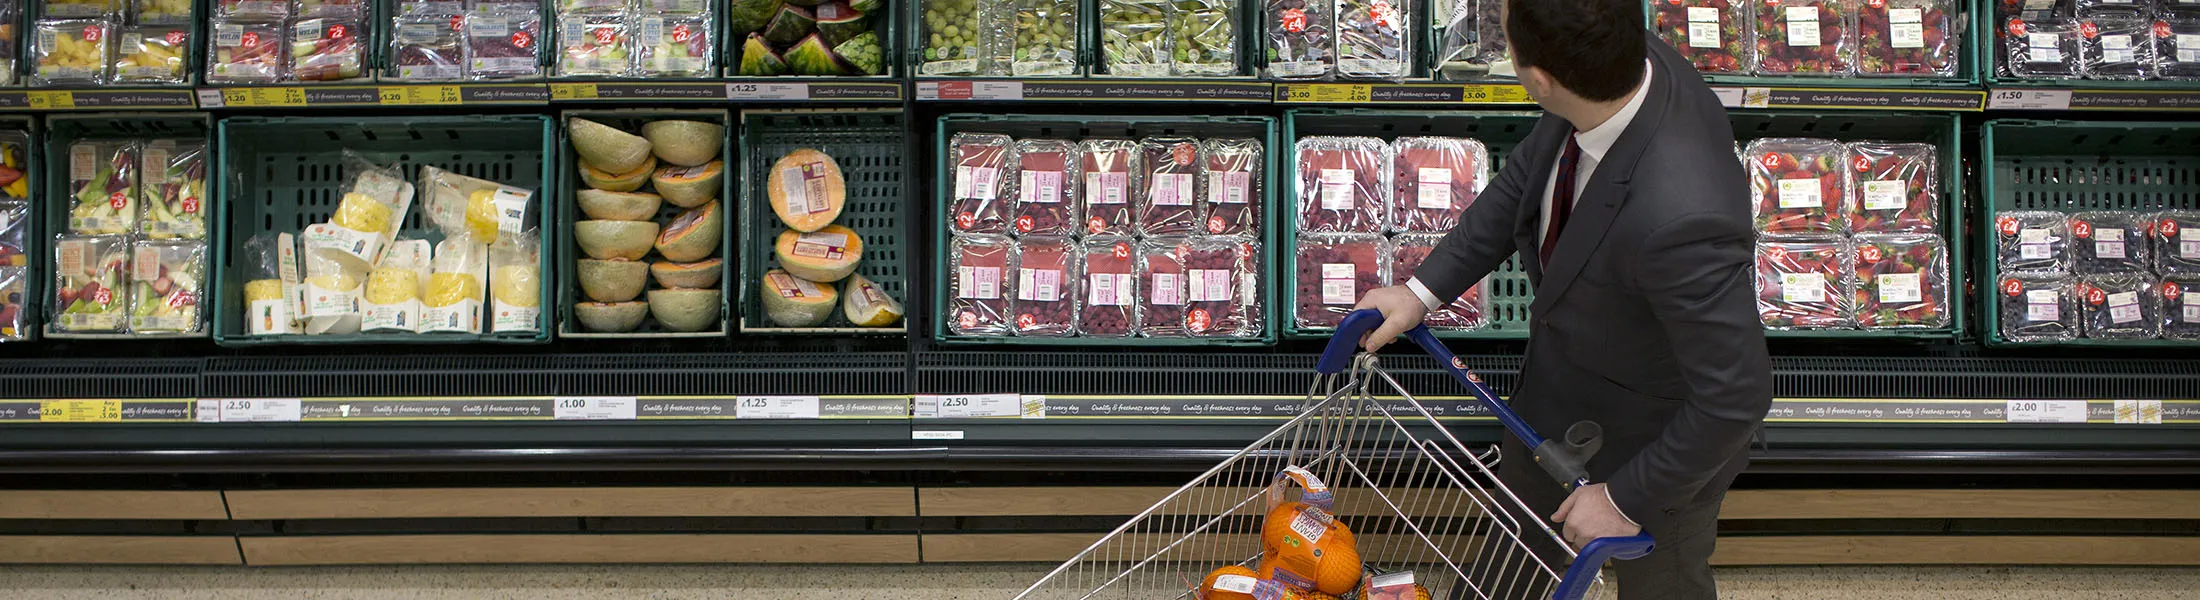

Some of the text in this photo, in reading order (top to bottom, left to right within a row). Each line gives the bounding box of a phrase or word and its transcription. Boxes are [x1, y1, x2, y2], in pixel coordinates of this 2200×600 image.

[1288, 18, 1303, 31] £4
[731, 85, 757, 93] £1.25
[1997, 92, 2022, 100] £1.50
[1766, 154, 1779, 166] £2
[1857, 157, 1868, 169] £2
[961, 214, 973, 227] £2
[1020, 218, 1031, 232] £2
[2003, 221, 2016, 233] £2
[2076, 224, 2088, 235] £2
[2163, 224, 2174, 234] £2
[1116, 246, 1127, 258] £2
[1864, 250, 1876, 261] £2
[2008, 282, 2020, 293] £2
[2165, 286, 2176, 297] £2
[2091, 290, 2102, 301] £2
[226, 401, 251, 410] £2.50
[560, 399, 585, 409] £1.00
[742, 398, 767, 407] £1.25
[943, 397, 968, 407] £2.50
[2012, 402, 2037, 412] £2.00
[373, 405, 393, 415] Quality
[399, 405, 424, 413] freshness
[424, 407, 440, 415] every
[440, 405, 451, 415] day
[462, 404, 482, 415] Quality
[489, 404, 514, 413] freshness
[514, 406, 530, 415] every
[530, 405, 541, 415] day
[643, 403, 663, 414] Quality
[669, 403, 694, 412] freshness
[695, 405, 710, 414] every
[711, 404, 722, 413] day
[825, 403, 845, 413] Quality
[851, 403, 876, 412] freshness
[877, 405, 893, 414] every
[893, 404, 904, 413] day
[1052, 405, 1068, 414] every
[1068, 404, 1079, 413] day
[1092, 404, 1111, 414] Quality
[1118, 404, 1143, 413] freshness
[1143, 405, 1159, 414] every
[1159, 404, 1171, 414] day
[1183, 404, 1203, 414] Quality
[1209, 404, 1234, 413] freshness
[1235, 405, 1251, 414] every
[1251, 404, 1262, 414] day
[1274, 404, 1294, 414] Quality
[1434, 404, 1445, 414] day
[1456, 404, 1476, 415] Quality
[1783, 407, 1794, 416] day
[1805, 406, 1825, 417] Quality
[1832, 406, 1856, 415] freshness
[1857, 408, 1872, 417] every
[1872, 407, 1884, 416] day
[1894, 406, 1914, 417] Quality
[1920, 406, 1945, 415] freshness
[1946, 408, 1961, 417] every
[1961, 407, 1973, 417] day
[1983, 407, 2003, 418] Quality
[1292, 522, 1318, 541] GIANT
